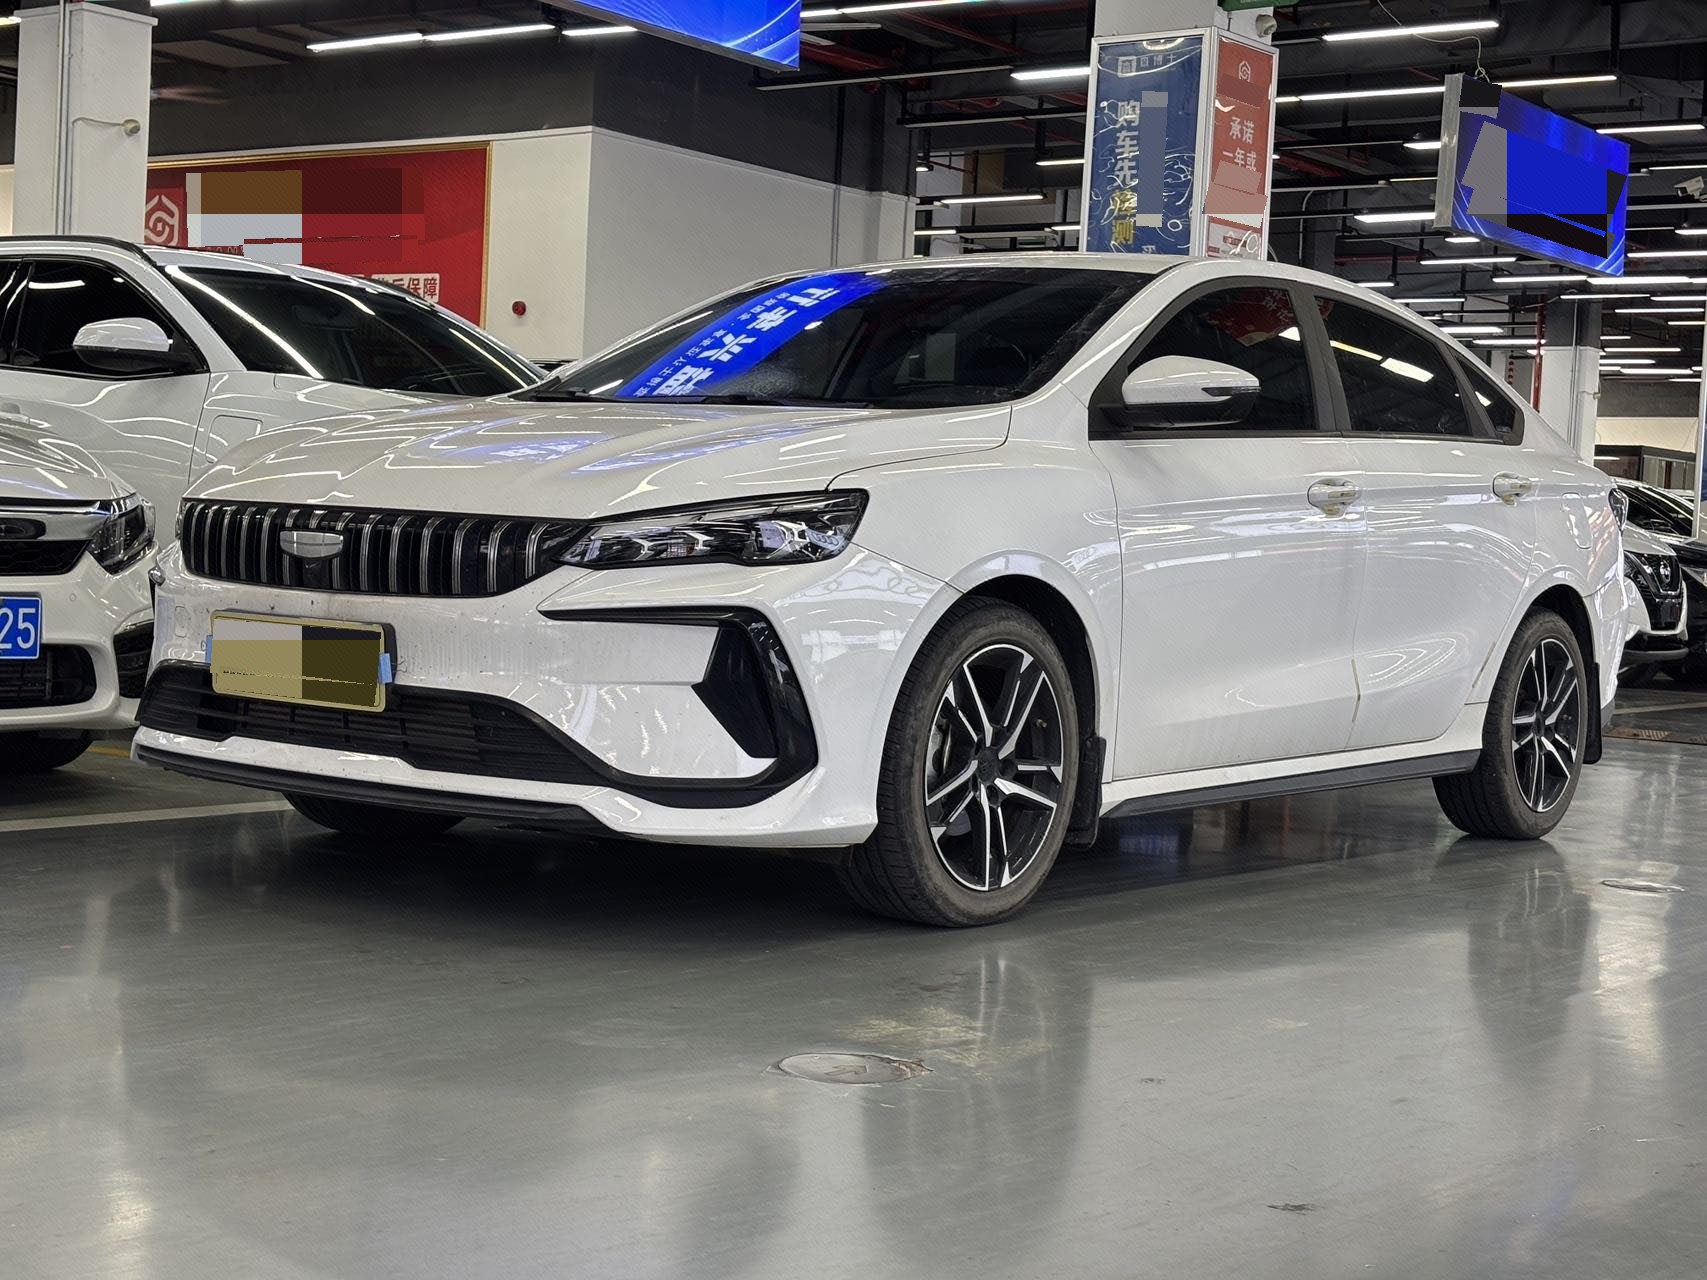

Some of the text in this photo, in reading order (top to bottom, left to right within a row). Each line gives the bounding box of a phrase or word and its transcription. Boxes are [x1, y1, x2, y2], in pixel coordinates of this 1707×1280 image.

[1229, 116, 1255, 145] 承诺
[1222, 146, 1257, 172] 一年或
